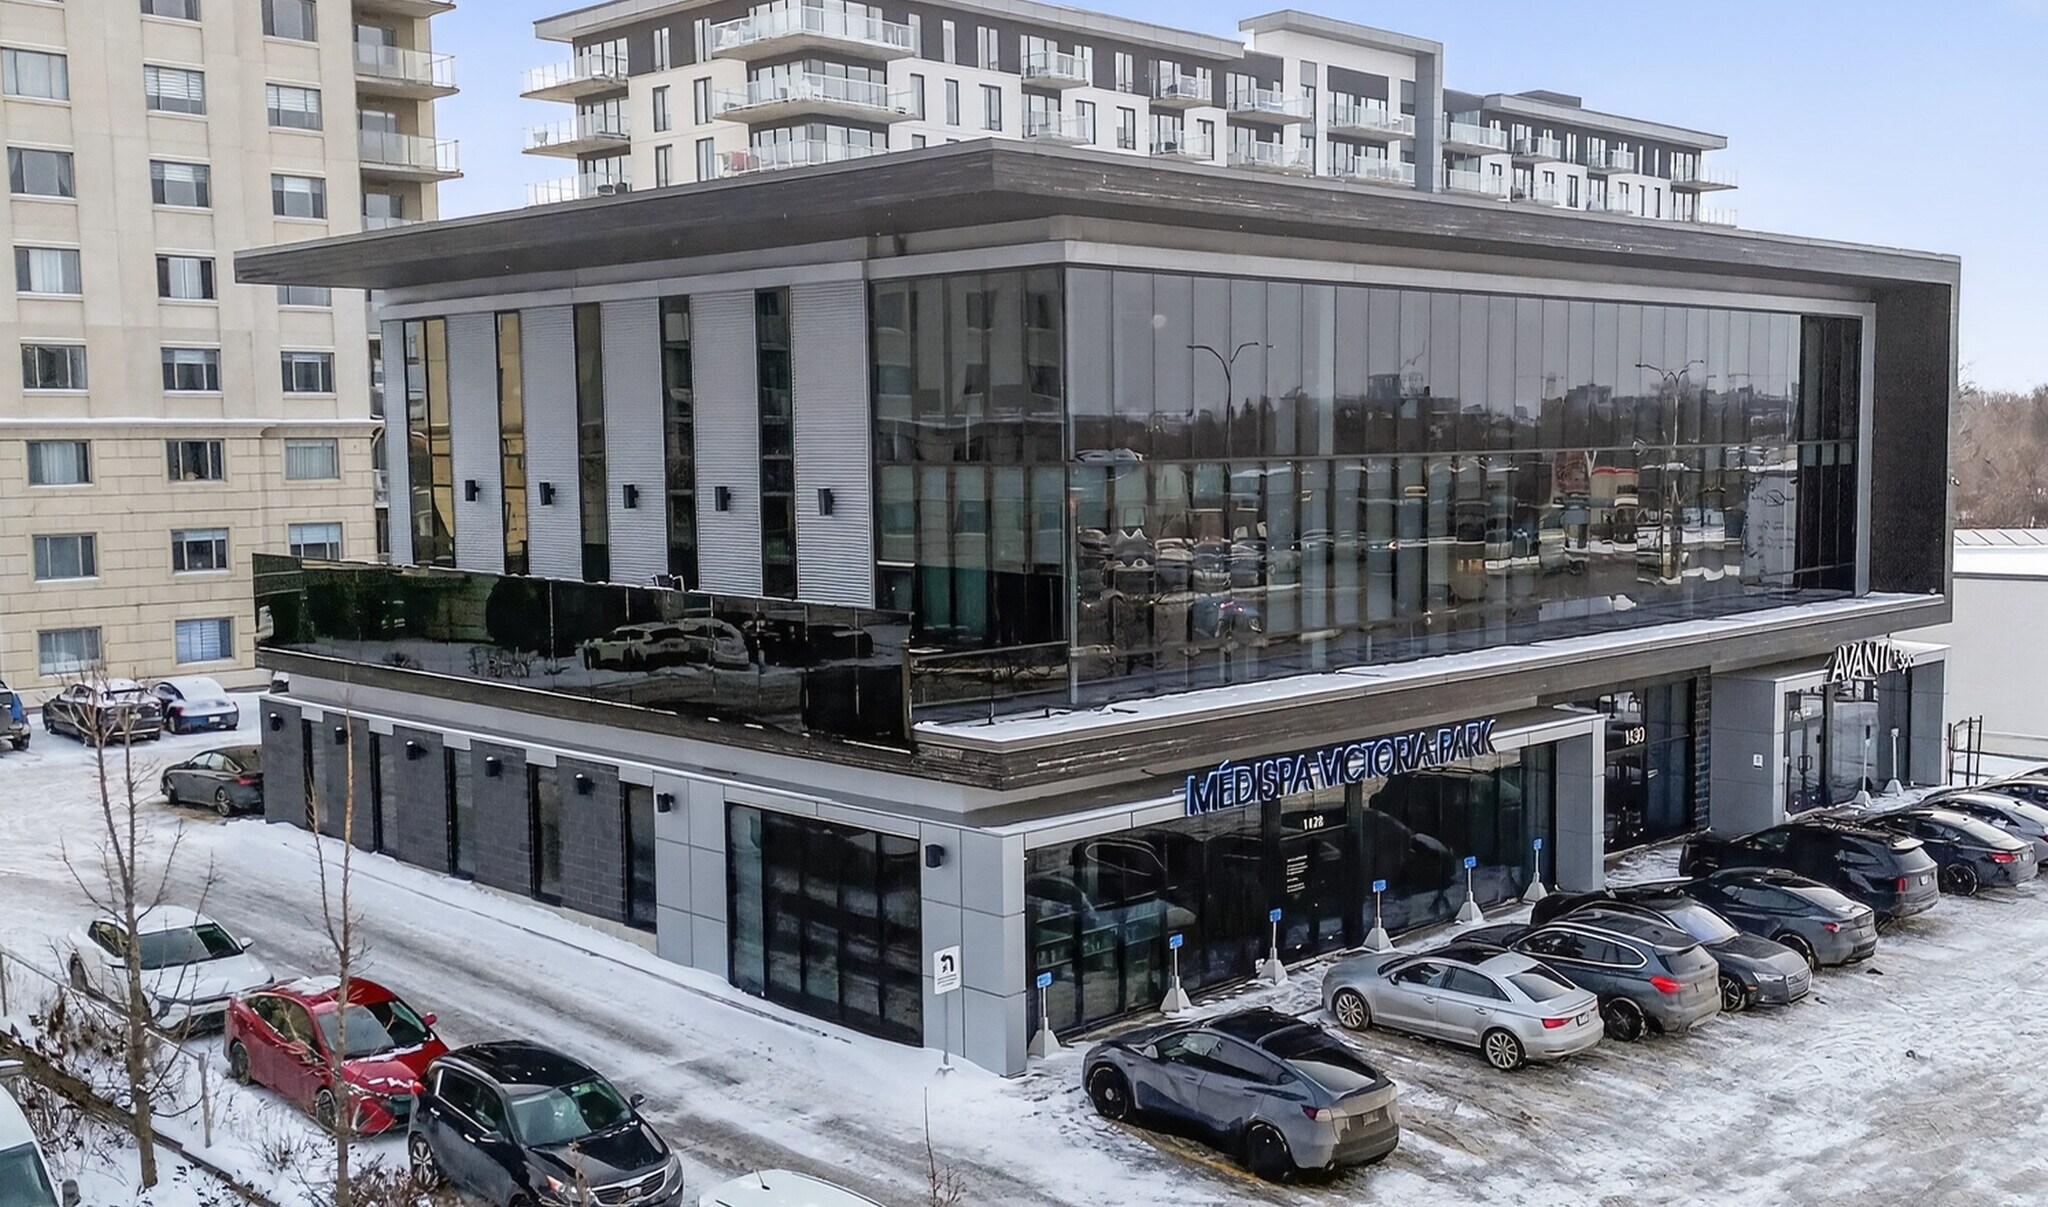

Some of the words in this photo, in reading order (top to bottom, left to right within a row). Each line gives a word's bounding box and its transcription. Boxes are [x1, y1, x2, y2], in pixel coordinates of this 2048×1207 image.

[1186, 755, 1315, 817] MÉDISPA
[1316, 732, 1434, 789] VICTORIA
[1435, 718, 1498, 765] PARK
